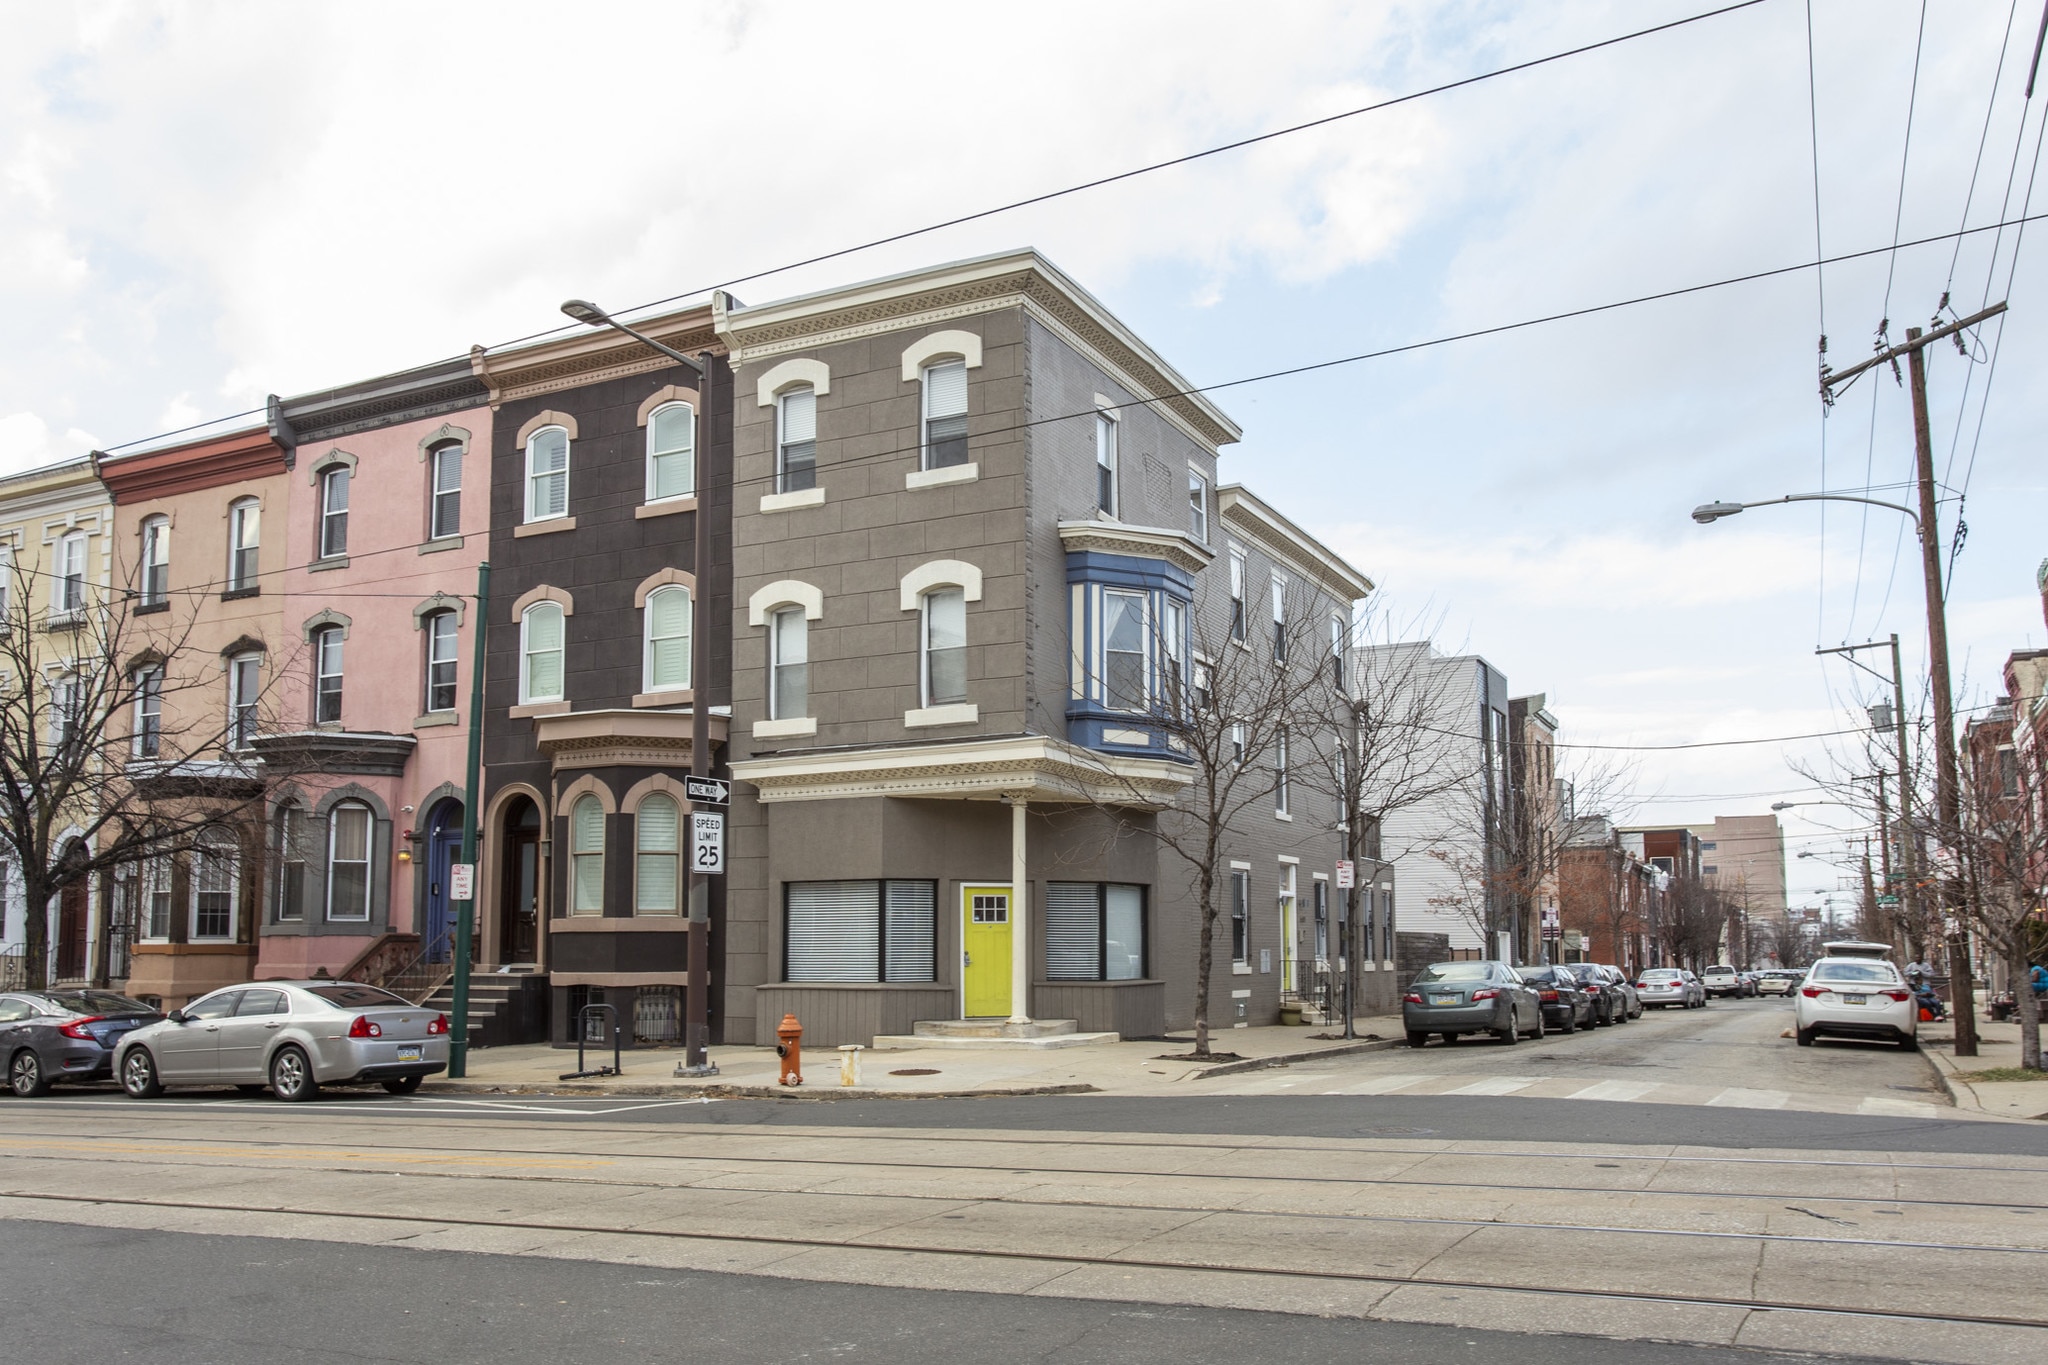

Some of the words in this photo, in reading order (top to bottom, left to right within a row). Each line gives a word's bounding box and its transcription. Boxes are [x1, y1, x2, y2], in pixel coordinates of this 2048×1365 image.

[690, 784, 703, 794] ONE
[705, 785, 717, 796] WAY
[696, 818, 720, 830] SPEED
[698, 832, 718, 841] LIMIT
[698, 845, 719, 866] 25
